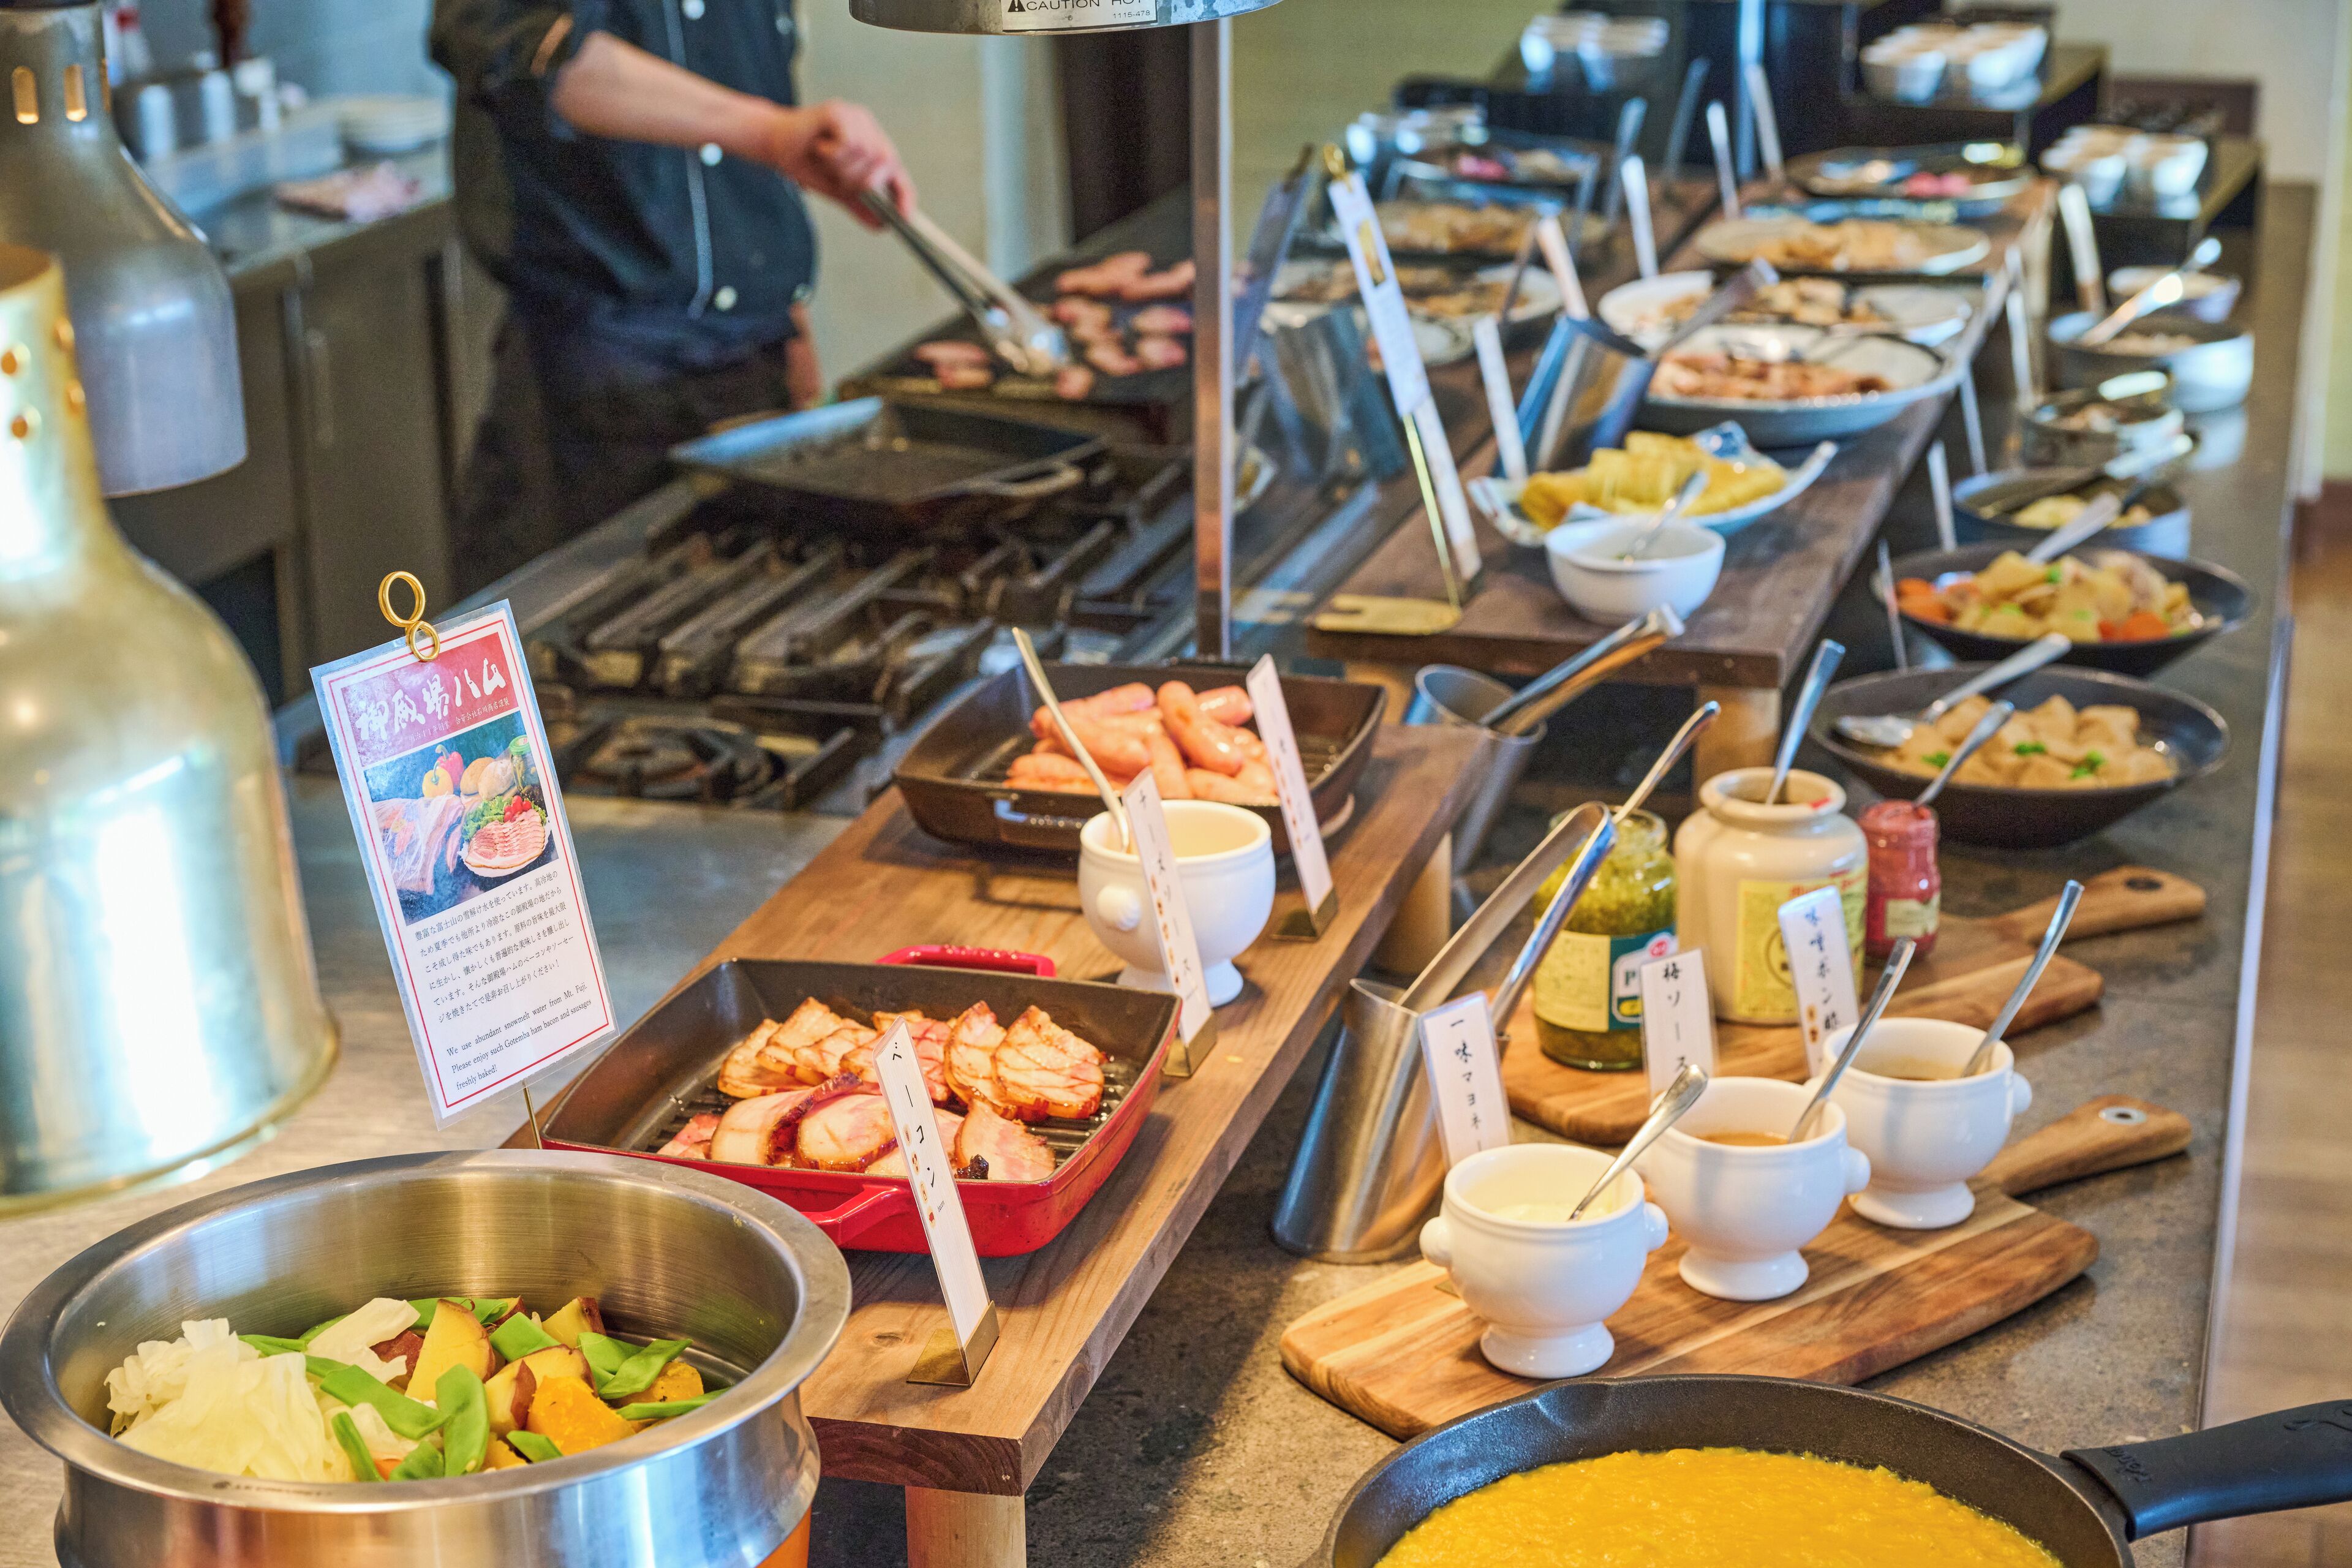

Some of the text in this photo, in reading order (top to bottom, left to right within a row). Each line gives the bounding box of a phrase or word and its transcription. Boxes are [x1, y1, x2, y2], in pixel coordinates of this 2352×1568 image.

[1027, 0, 1099, 10] CAUTION
[1113, 10, 1151, 18] 1115-478
[355, 657, 506, 741] 御殿場ハム
[447, 982, 587, 1056] We use abundant snowmelt water from Mt. Fuji.
[451, 999, 591, 1073] Please enjoy such Gotemba ham bacon and sausages
[1662, 962, 1691, 1073] 梅ソース
[456, 1064, 497, 1090] freshly baked!
[892, 1042, 935, 1188] ベーコン
